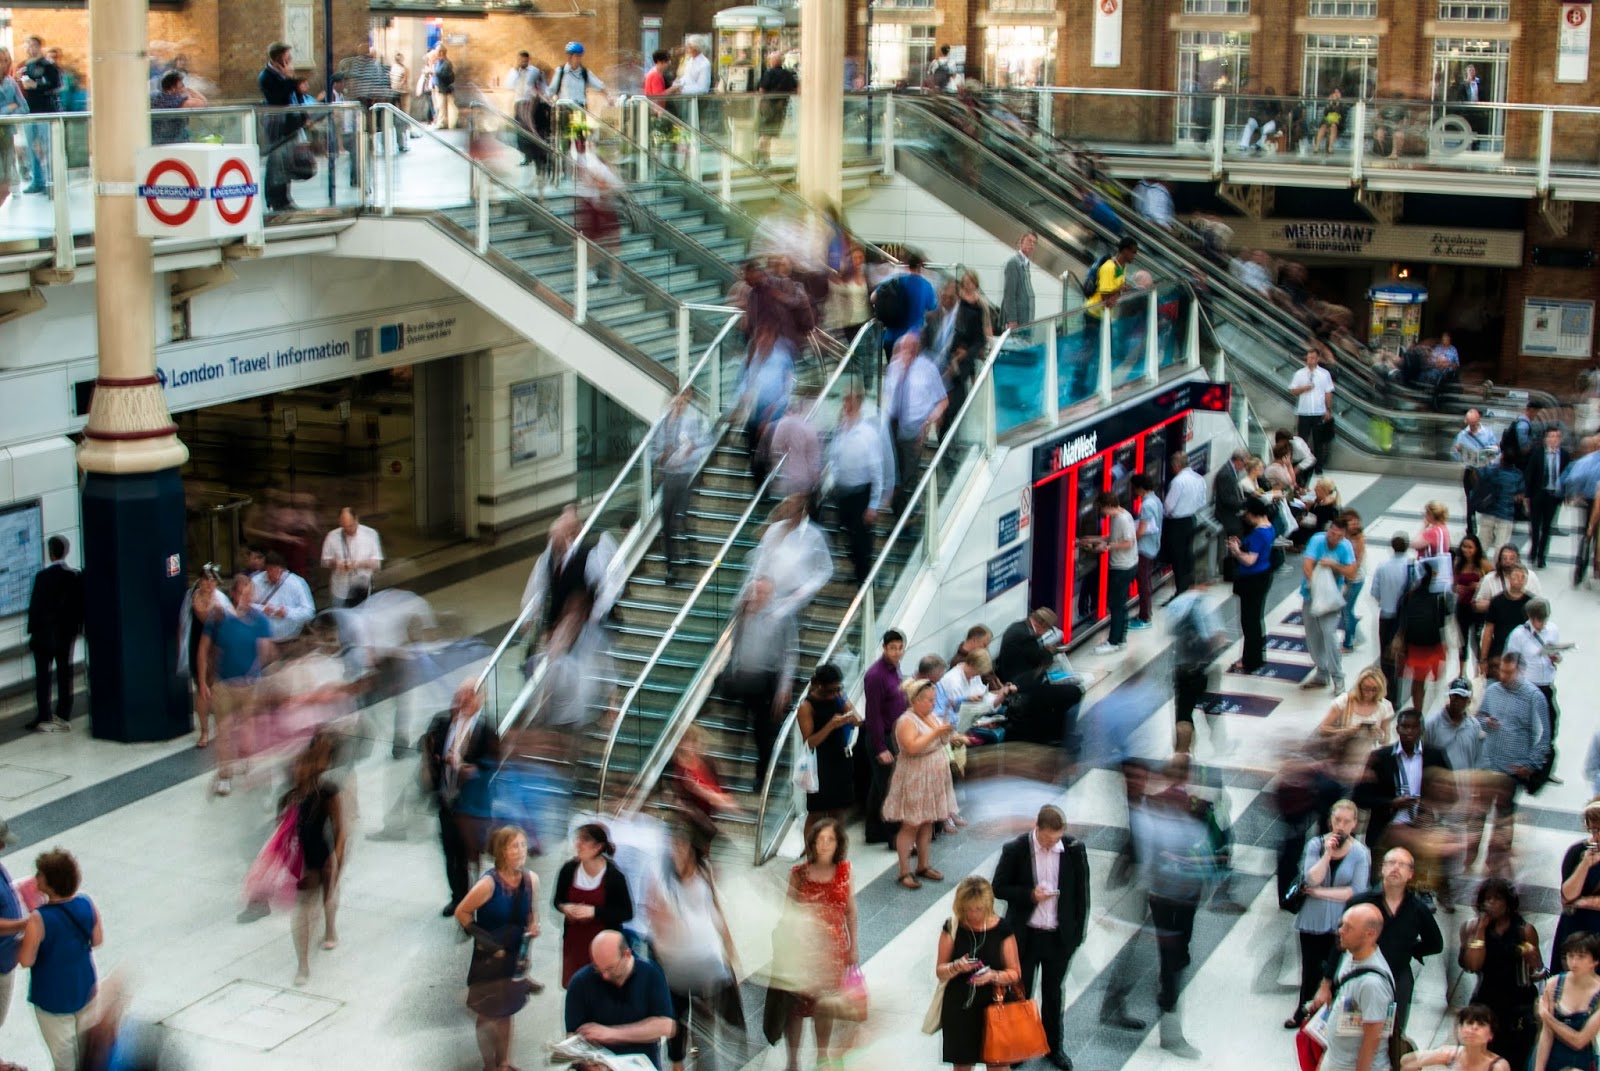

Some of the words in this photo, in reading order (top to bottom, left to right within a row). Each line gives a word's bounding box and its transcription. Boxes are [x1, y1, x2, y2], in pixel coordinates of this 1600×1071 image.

[1572, 9, 1583, 24] B
[142, 184, 203, 198] UNDERGROUND
[212, 184, 256, 197] UNDERGROUND
[1283, 222, 1376, 243] MERCHANT
[172, 362, 224, 388] London
[230, 351, 271, 375] Travel
[276, 339, 350, 368] Information
[1062, 430, 1097, 468] NatWest
